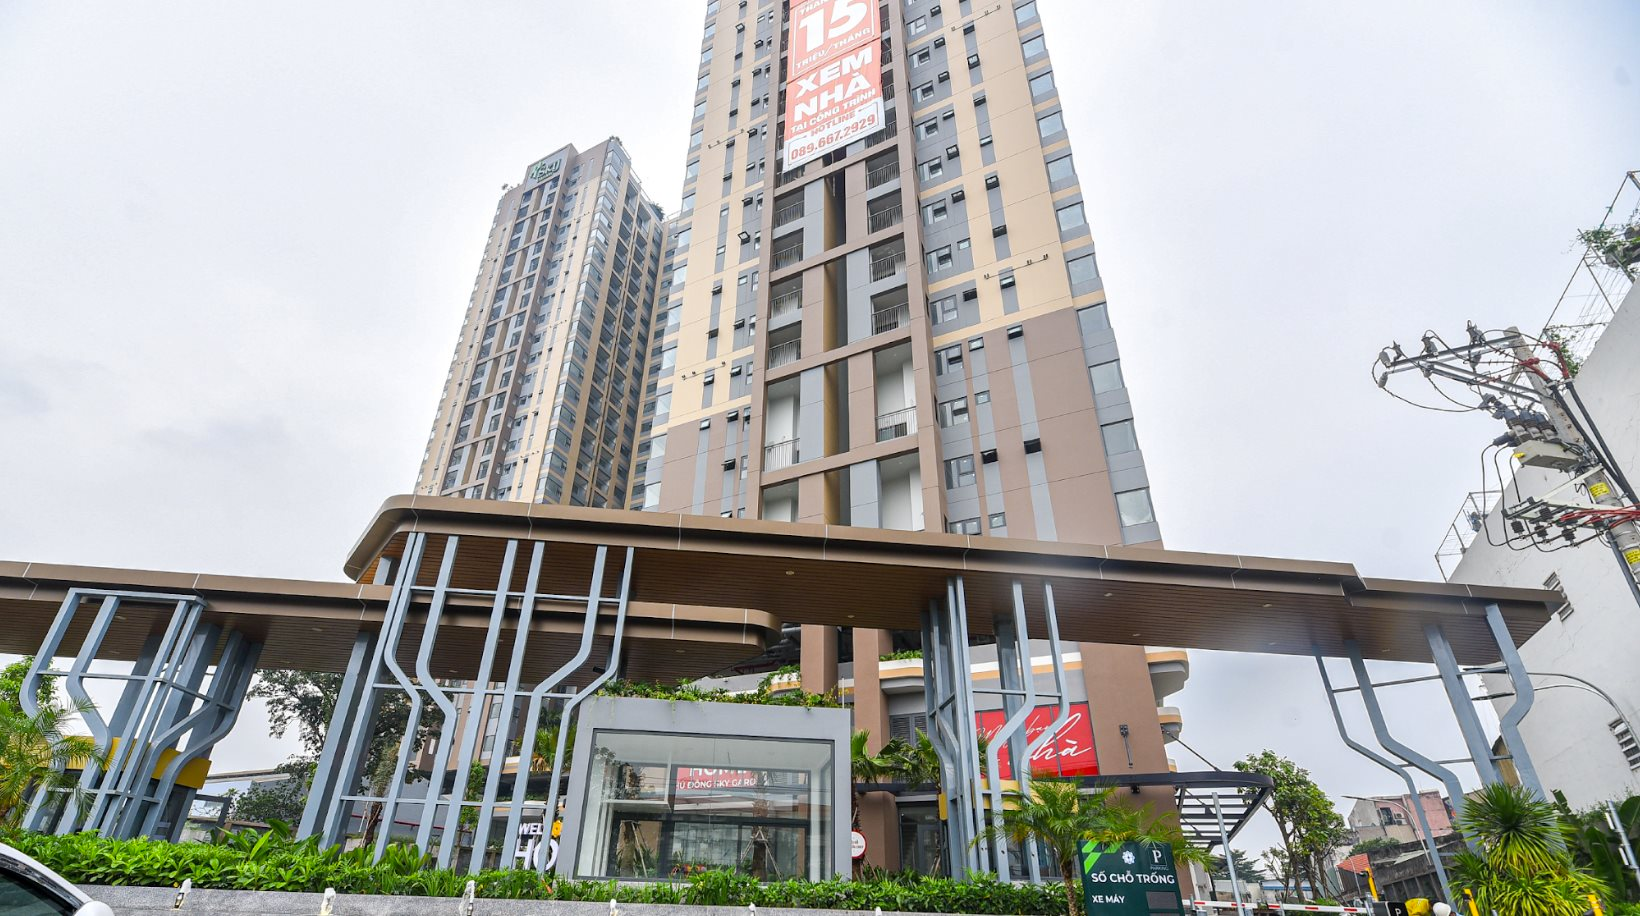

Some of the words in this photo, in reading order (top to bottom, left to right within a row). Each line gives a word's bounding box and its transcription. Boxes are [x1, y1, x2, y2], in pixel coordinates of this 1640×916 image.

[799, 0, 867, 53] 15
[796, 46, 872, 98] XEM
[794, 72, 871, 122] NHÀ
[791, 113, 876, 160] 089.667.2929
[810, 110, 856, 137] HOTLINE
[1152, 849, 1162, 864] P
[1091, 870, 1107, 883] SỐ
[1109, 870, 1134, 884] CHỖ
[1136, 872, 1175, 884] TRỐNG
[1092, 895, 1103, 904] XE
[1105, 893, 1125, 904] MÁY
